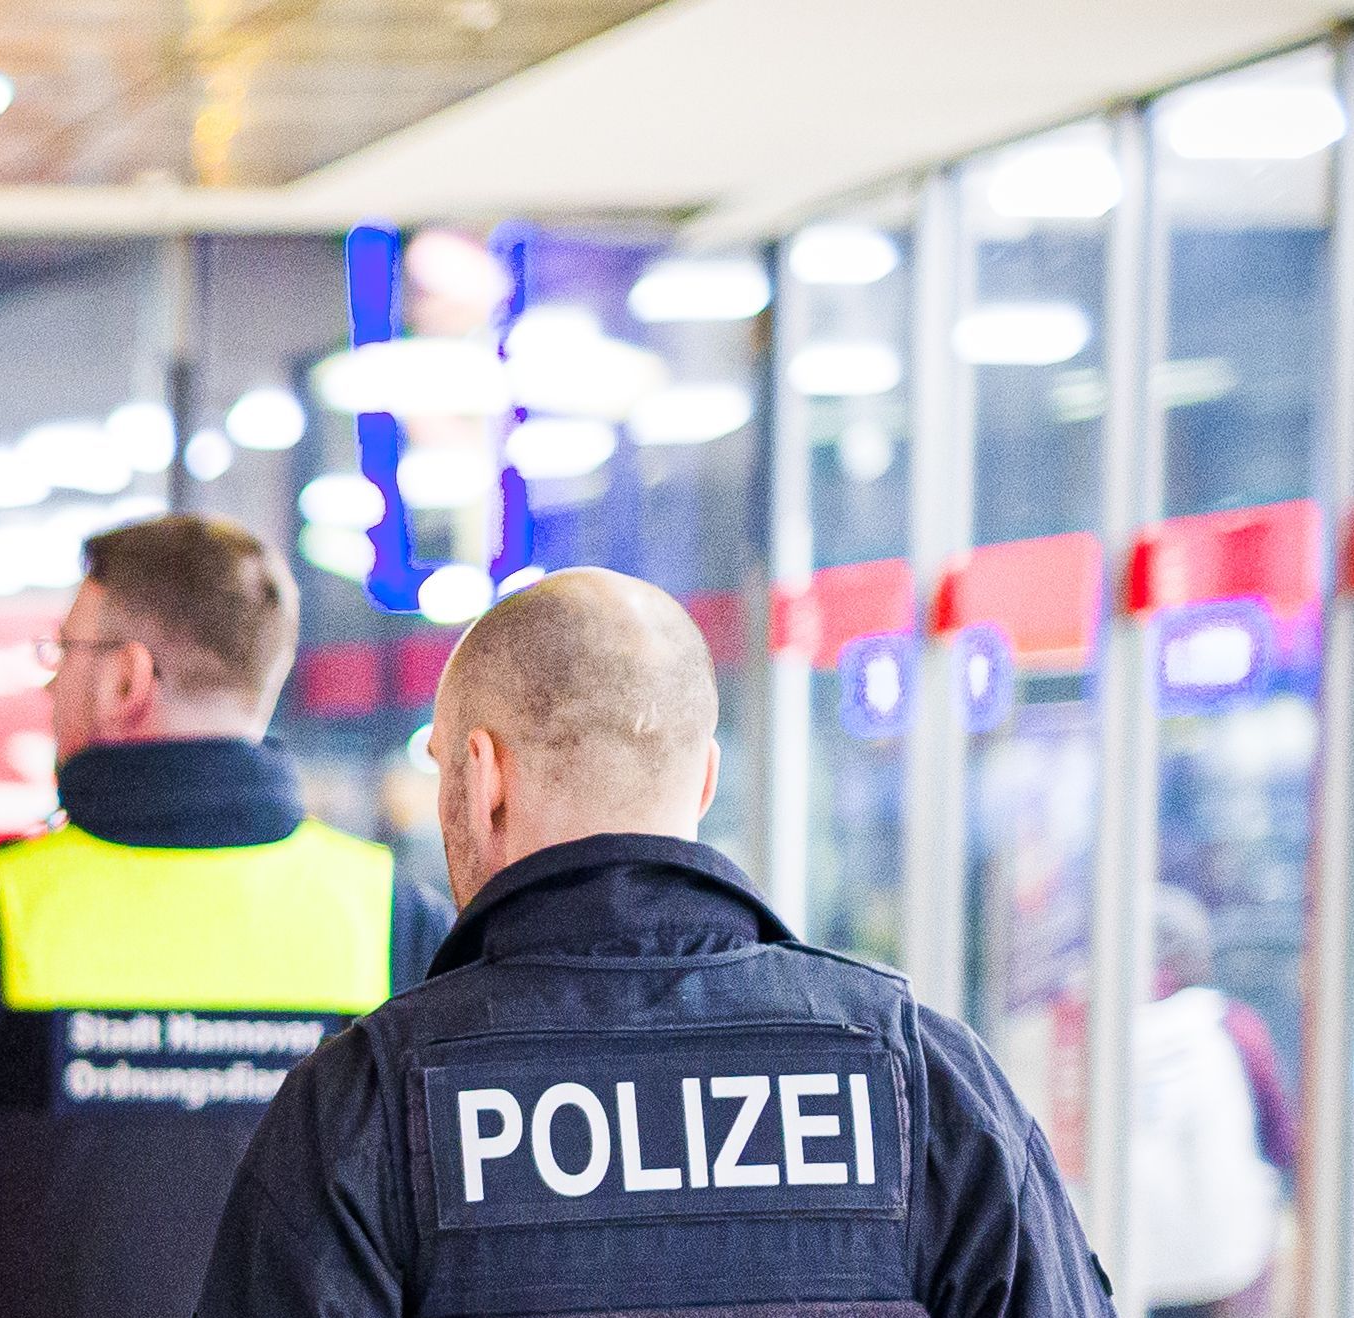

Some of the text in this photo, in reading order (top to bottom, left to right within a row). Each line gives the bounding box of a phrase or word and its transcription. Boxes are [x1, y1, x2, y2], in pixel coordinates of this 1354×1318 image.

[68, 1012, 324, 1054] Stadt Hannover
[458, 1073, 876, 1203] POLIZEI
